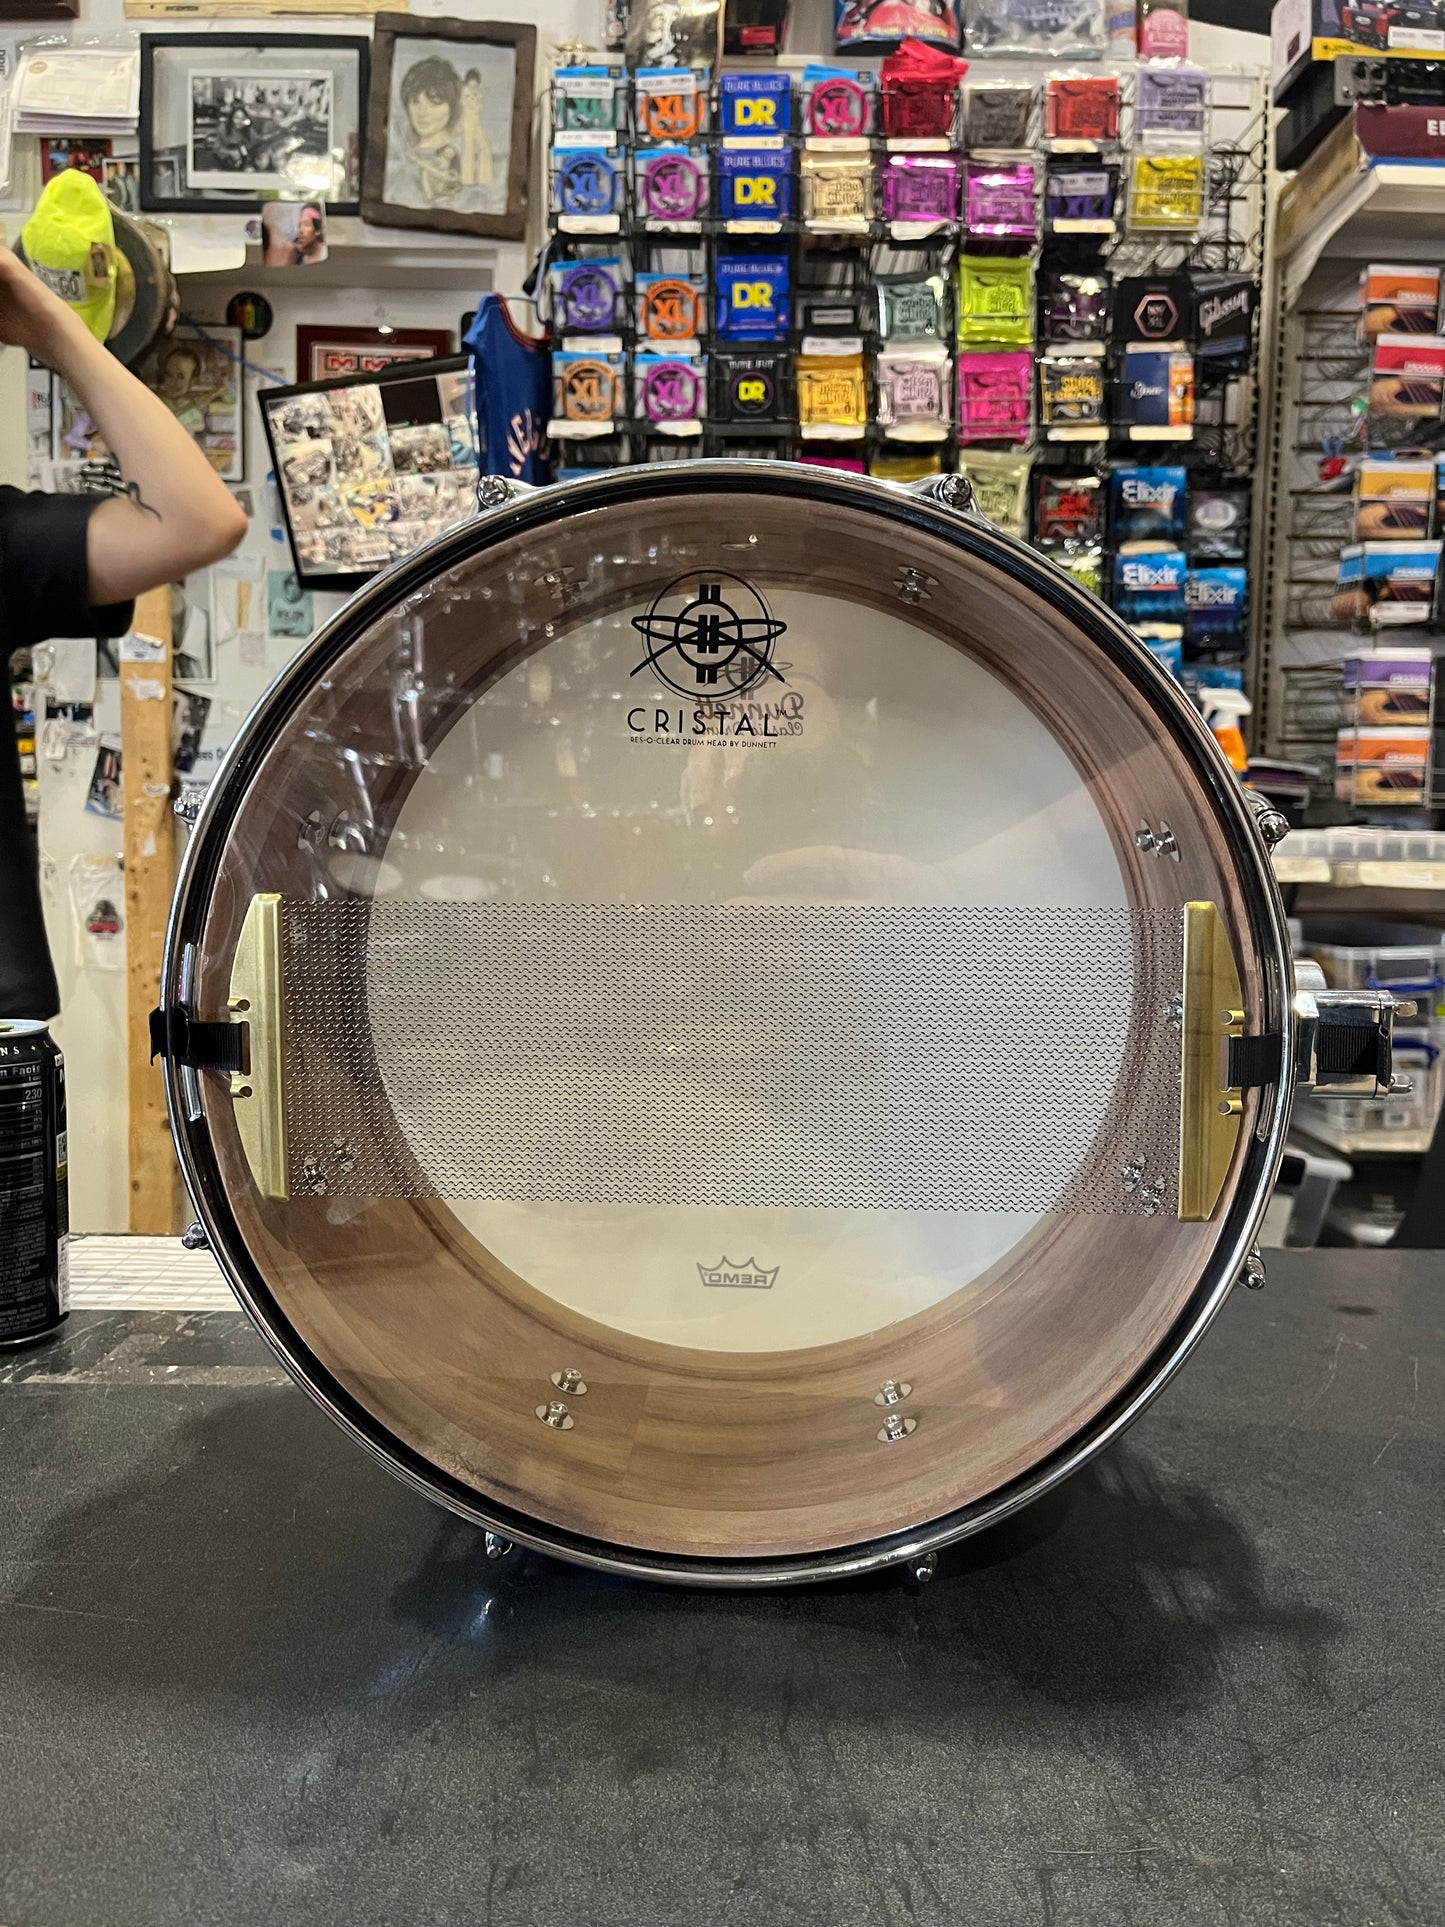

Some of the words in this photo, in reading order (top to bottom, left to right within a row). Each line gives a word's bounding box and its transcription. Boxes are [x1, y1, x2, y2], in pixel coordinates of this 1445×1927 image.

[654, 95, 691, 121] XL
[734, 98, 776, 126] DR
[821, 97, 856, 124] XL
[569, 172, 607, 200] XL
[655, 175, 692, 199] XL
[734, 177, 776, 205] DR
[571, 284, 607, 308] XL
[732, 281, 773, 309] DR
[653, 298, 689, 323] XL
[570, 378, 608, 403] XL
[654, 380, 688, 405] XL
[738, 381, 766, 402] DR
[1122, 480, 1178, 503] Elixir
[1122, 563, 1179, 586] Elixir
[1184, 581, 1238, 605] Elixir
[630, 736, 680, 745] RES-O-CLEAR
[683, 738, 704, 746] DRUM
[707, 739, 727, 747] HEAD
[742, 740, 777, 749] DUNNETT
[25, 1088, 42, 1100] 230
